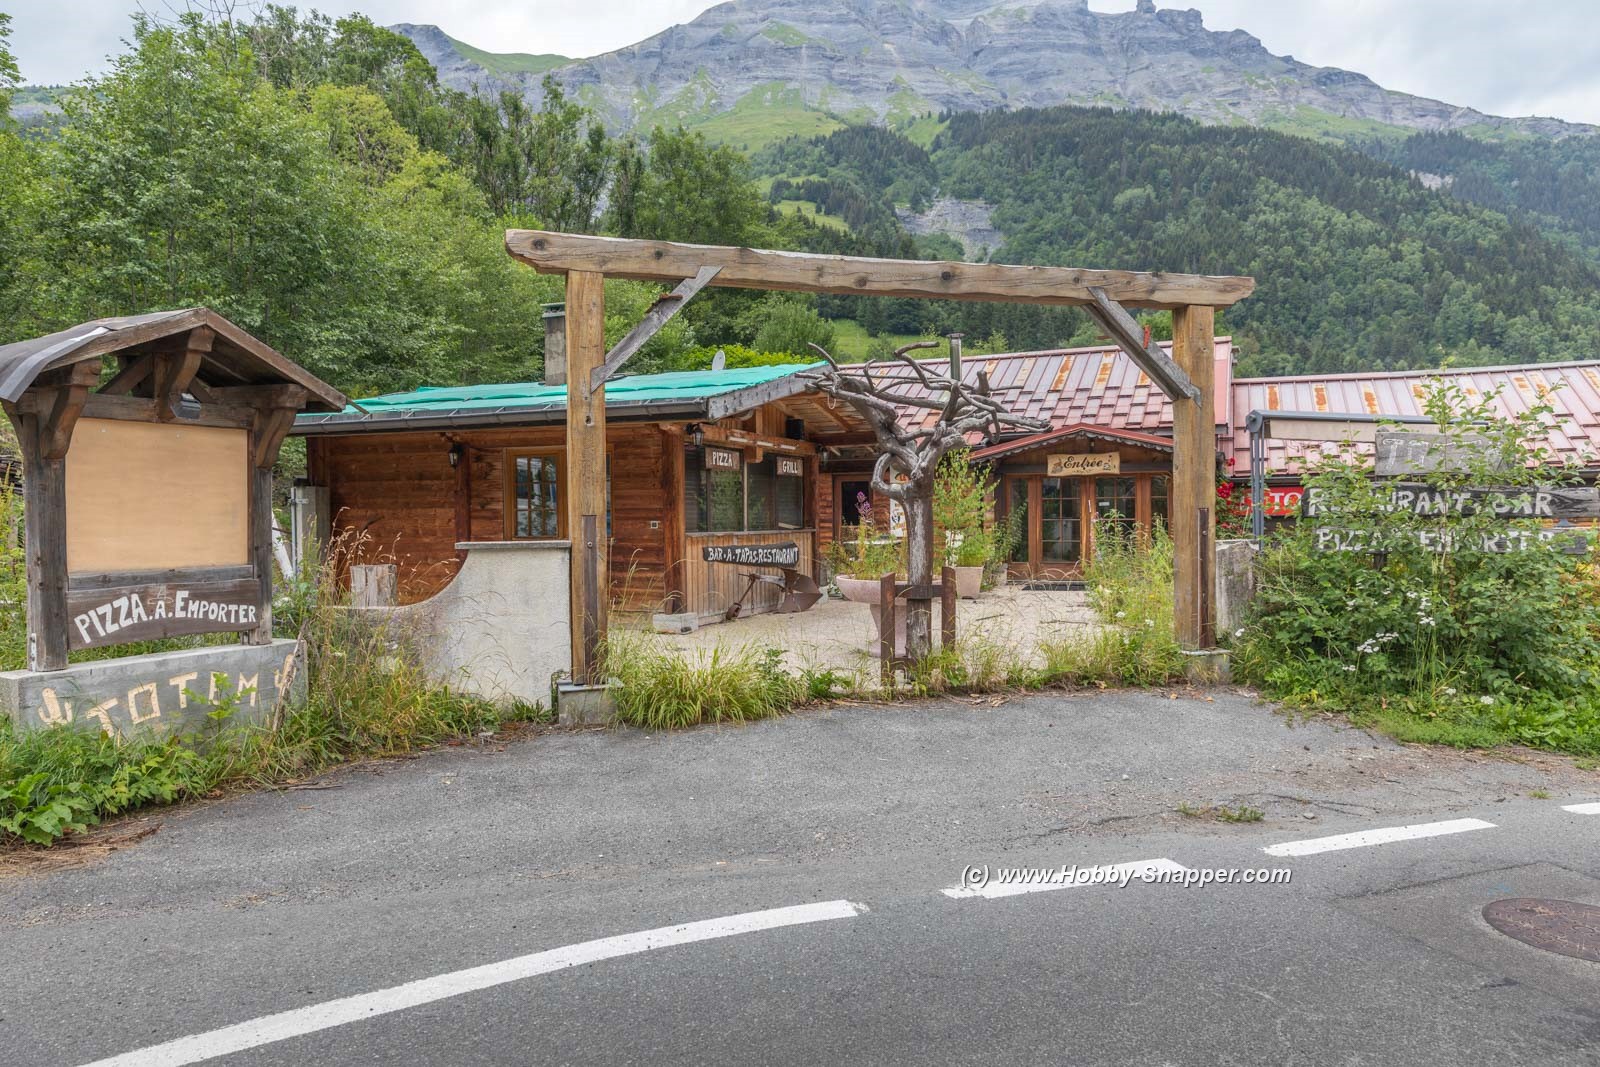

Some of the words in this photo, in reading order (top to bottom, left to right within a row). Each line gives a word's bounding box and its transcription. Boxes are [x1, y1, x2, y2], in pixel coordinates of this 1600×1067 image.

[712, 451, 733, 467] PIZZA
[782, 460, 798, 474] GRILL
[1063, 456, 1103, 470] Entrée
[708, 547, 723, 561] BAR
[735, 547, 757, 563] TAPAS
[74, 593, 147, 644] PIZZA
[175, 590, 256, 623] EMPORTER
